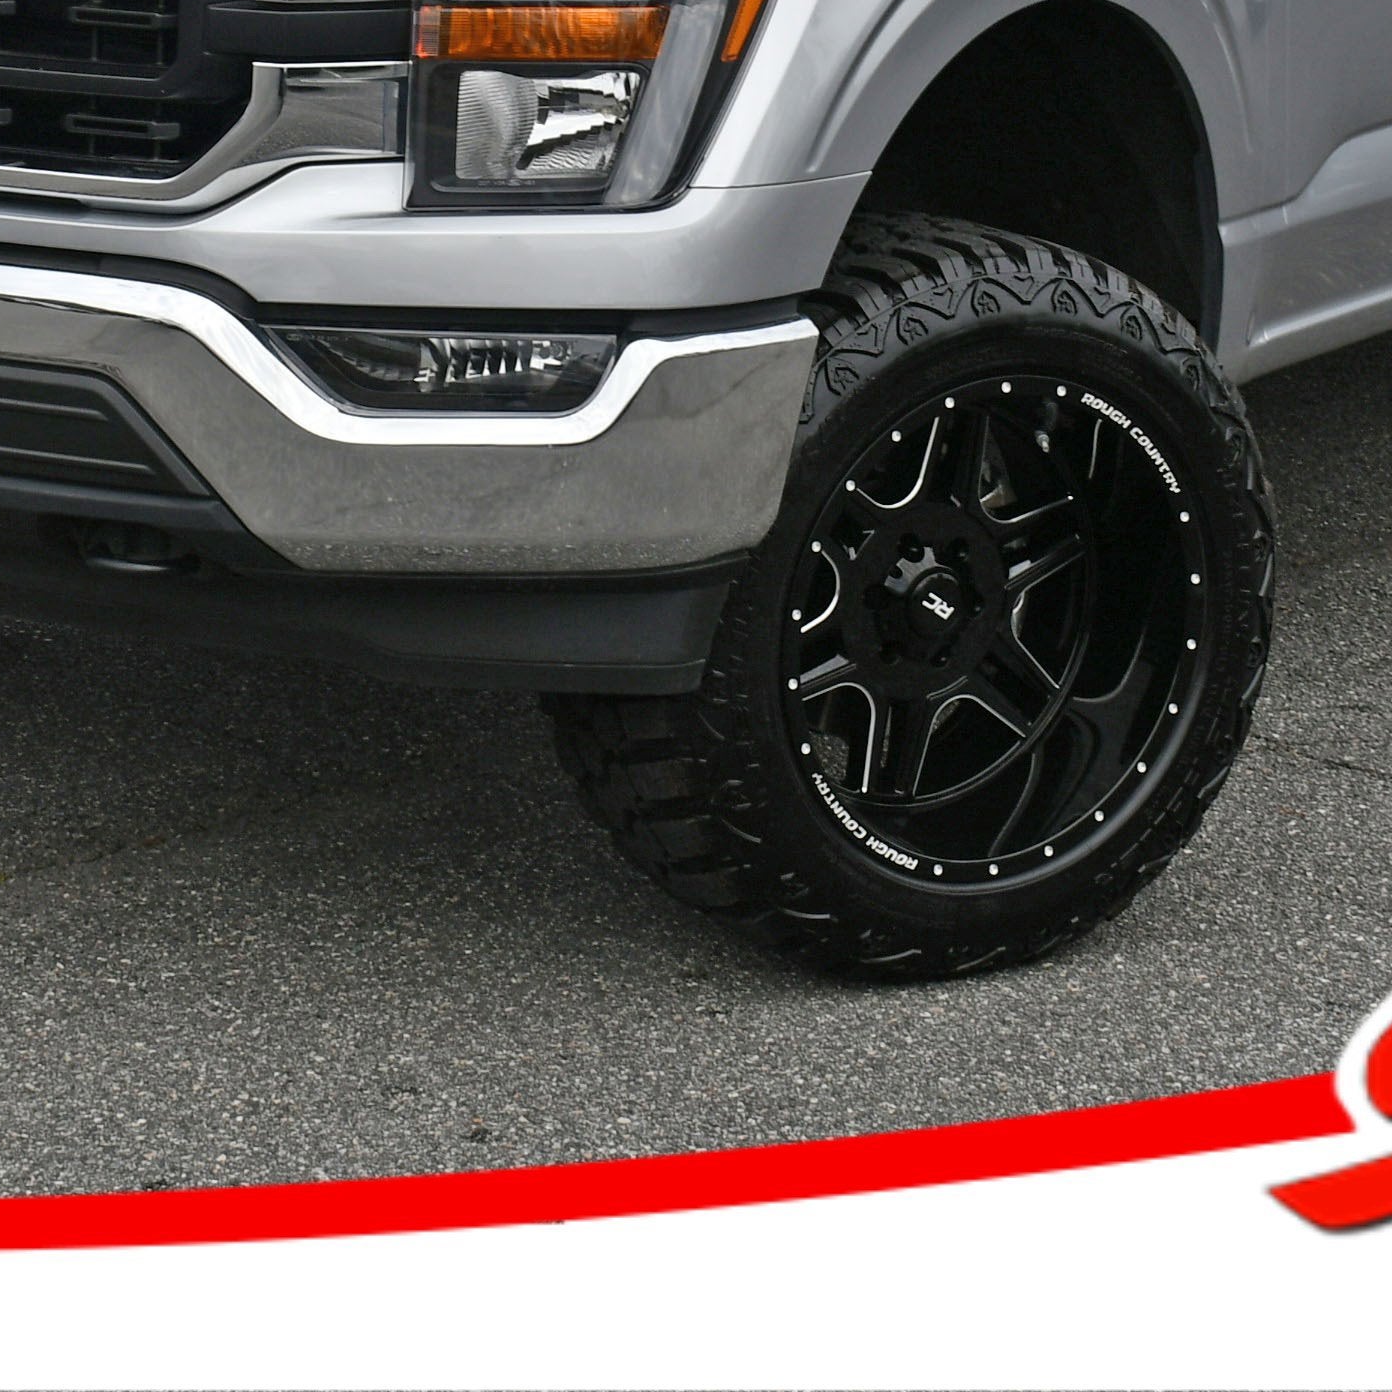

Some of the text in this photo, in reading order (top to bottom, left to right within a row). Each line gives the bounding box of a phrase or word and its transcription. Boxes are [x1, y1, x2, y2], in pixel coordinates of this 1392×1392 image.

[1081, 392, 1181, 494] ROUGH COUNTRY
[922, 592, 955, 620] RC
[811, 772, 919, 871] ROUGH COUNTRY
